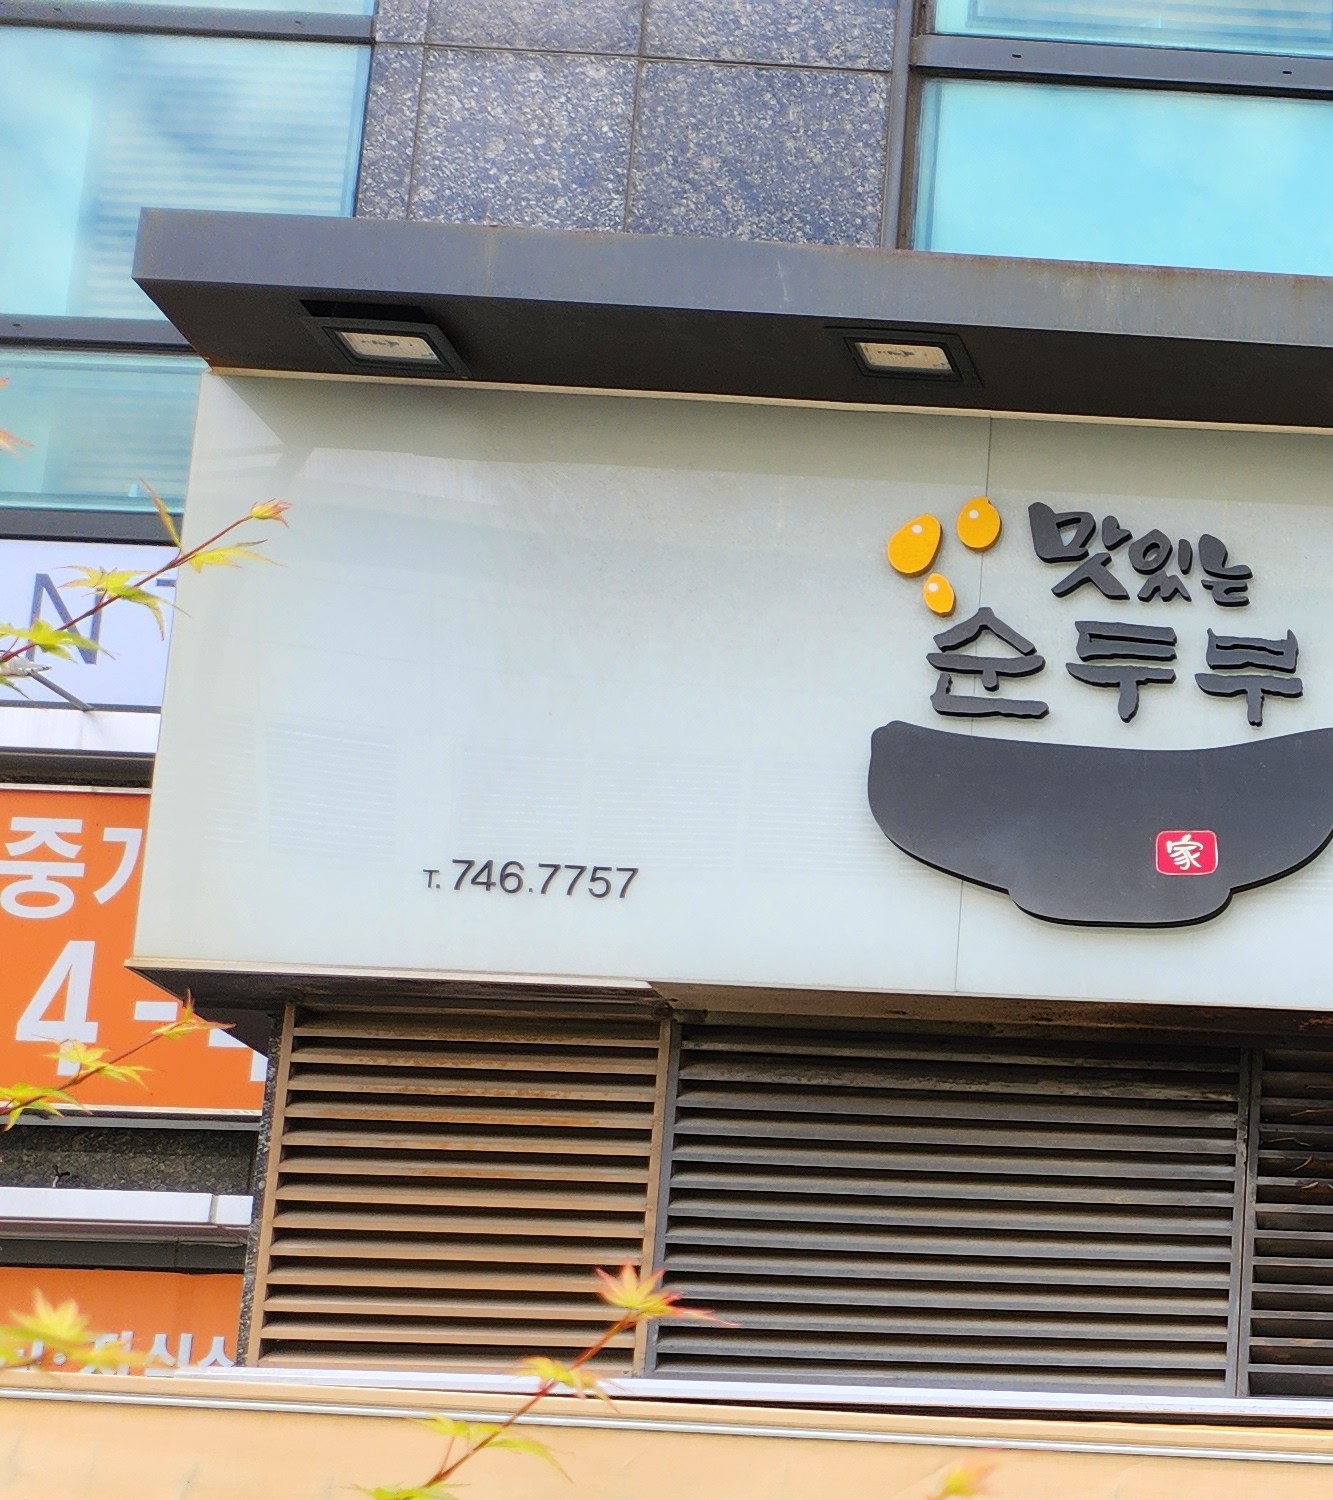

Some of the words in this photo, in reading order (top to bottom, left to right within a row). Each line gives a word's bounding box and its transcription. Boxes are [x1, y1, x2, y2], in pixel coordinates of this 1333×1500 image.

[1028, 502, 1254, 607] 맛있는
[926, 607, 1304, 727] 순두부
[1166, 834, 1204, 871] 家
